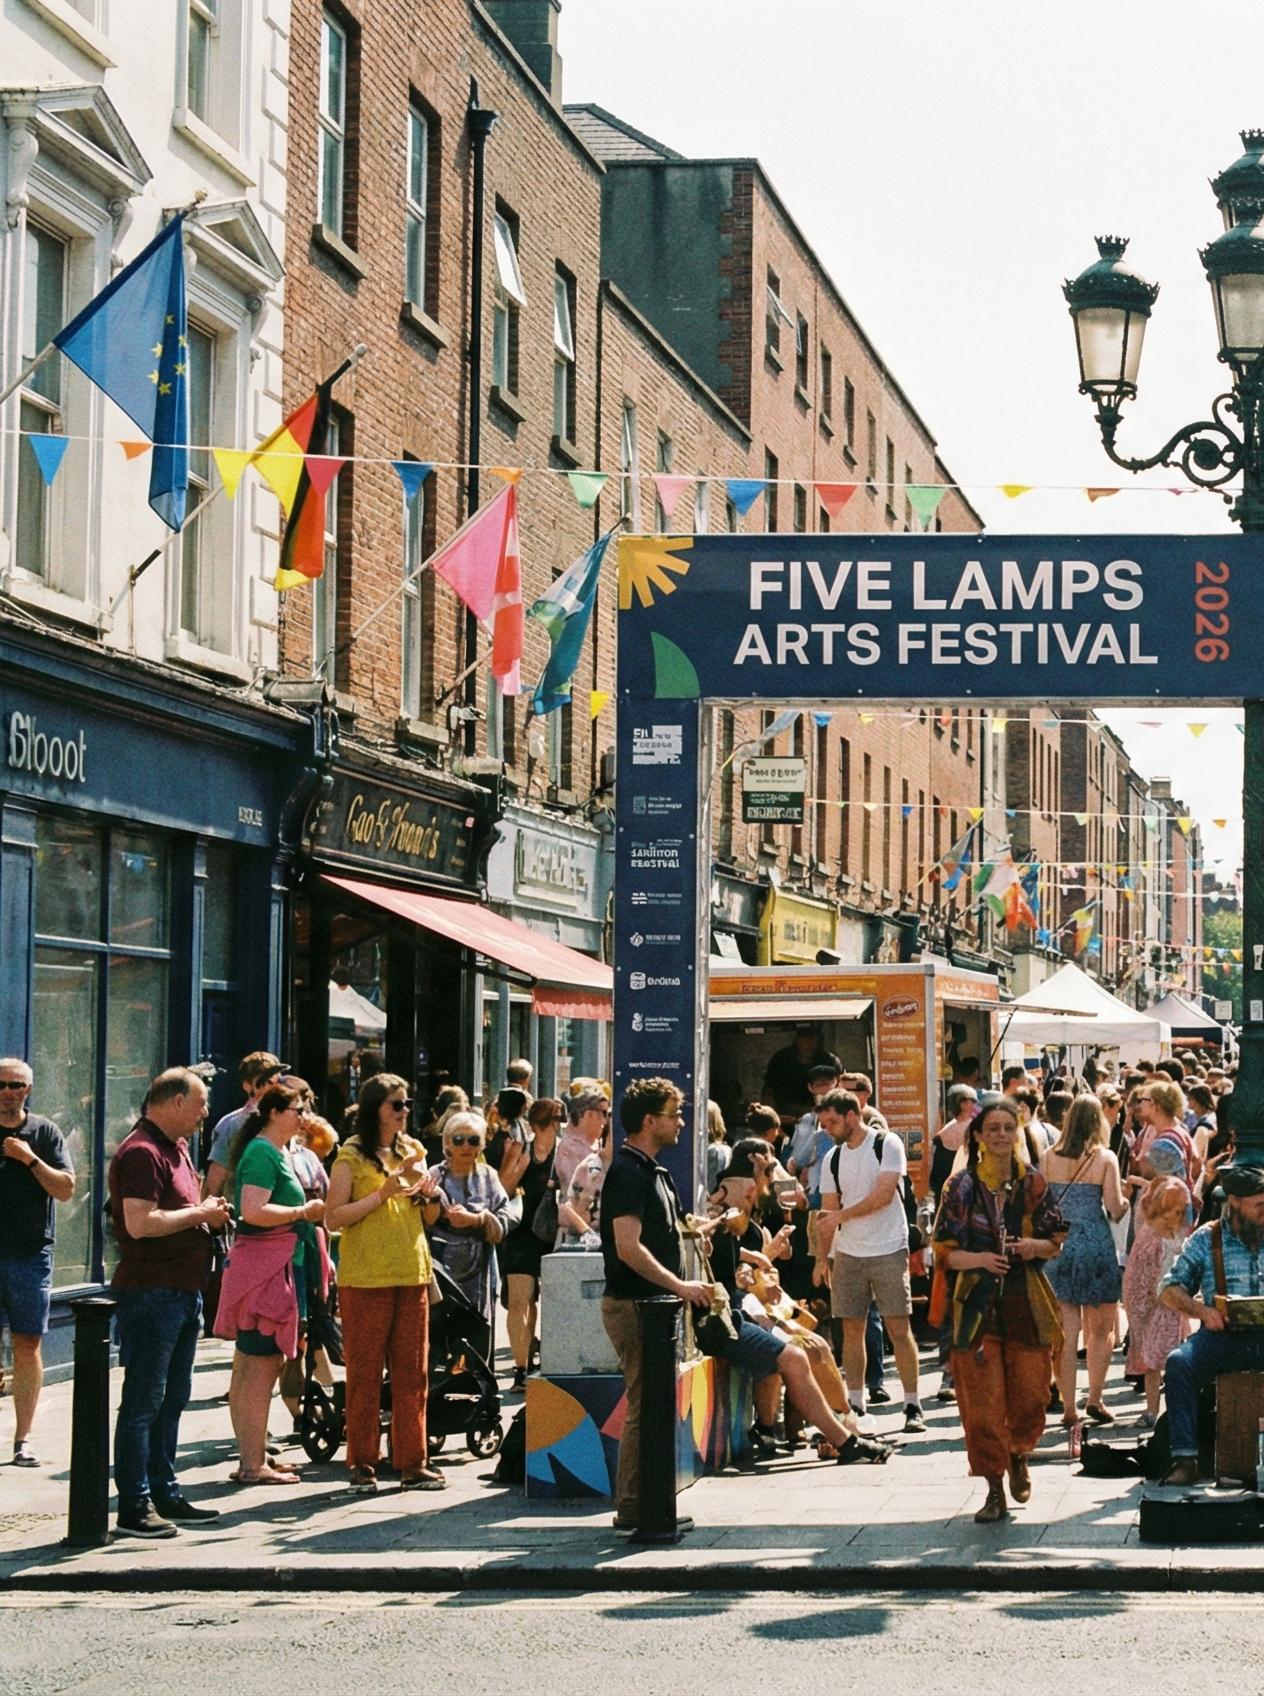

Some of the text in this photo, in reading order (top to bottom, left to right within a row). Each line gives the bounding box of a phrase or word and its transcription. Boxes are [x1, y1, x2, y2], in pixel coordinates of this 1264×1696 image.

[750, 559, 1144, 611] FIVE LAMPS
[1194, 561, 1231, 662] 2026
[733, 622, 1159, 666] ARTS FESTIVAL
